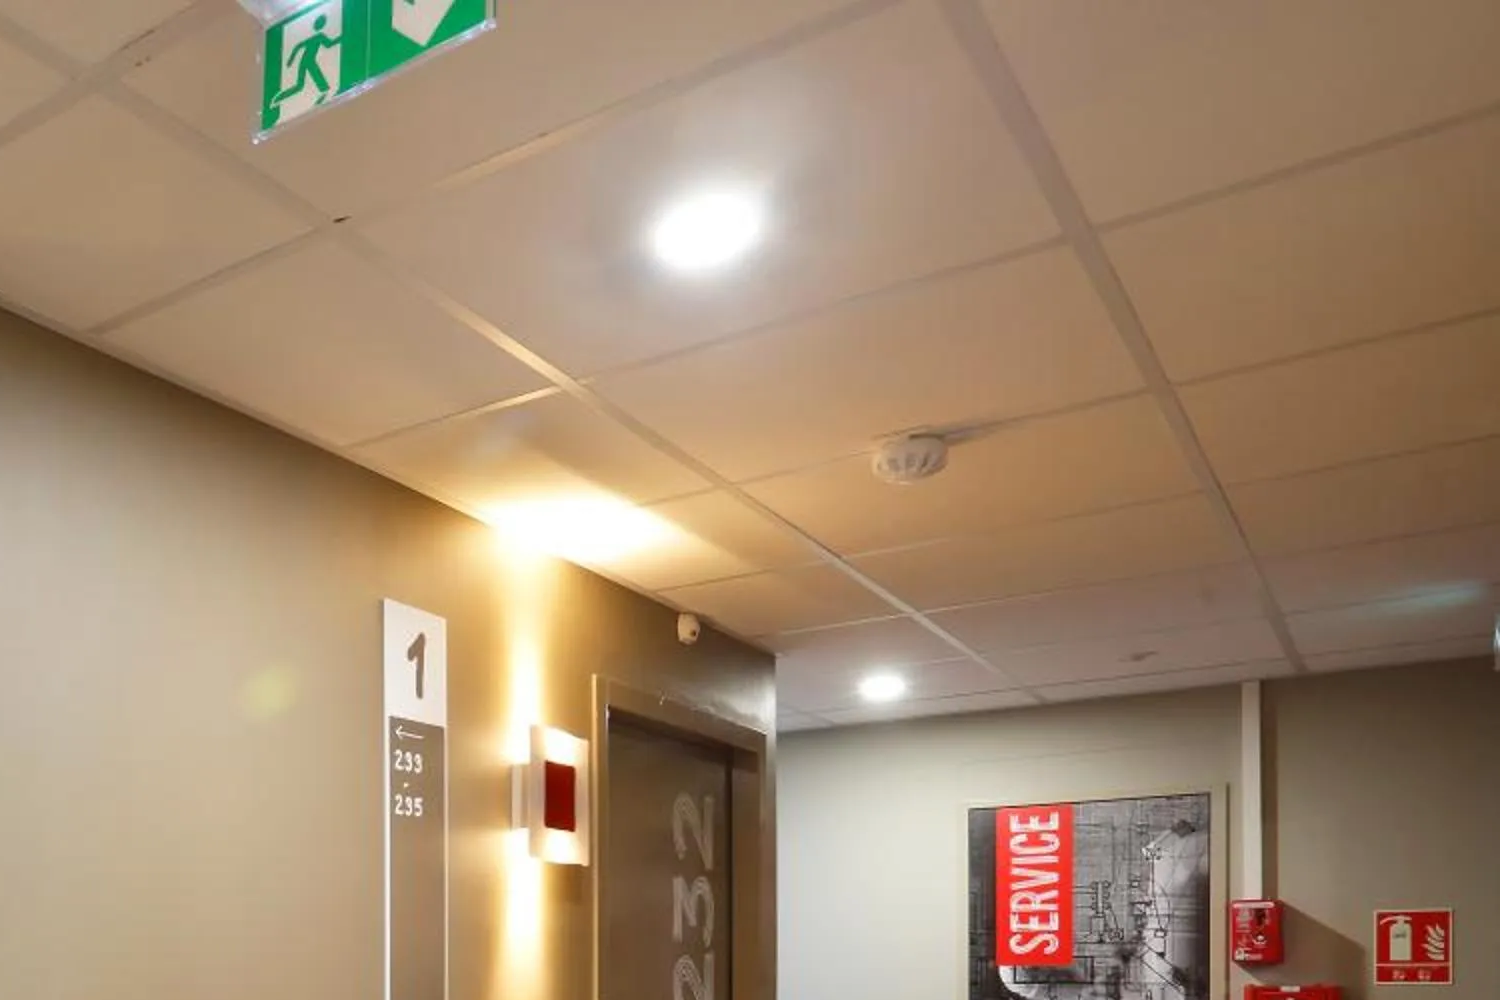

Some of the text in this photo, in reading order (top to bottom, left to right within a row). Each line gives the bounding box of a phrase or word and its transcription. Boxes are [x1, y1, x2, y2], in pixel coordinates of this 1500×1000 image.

[407, 631, 426, 700] 1
[394, 750, 423, 774] 233
[394, 795, 423, 817] 235
[1009, 811, 1060, 955] SERVICE
